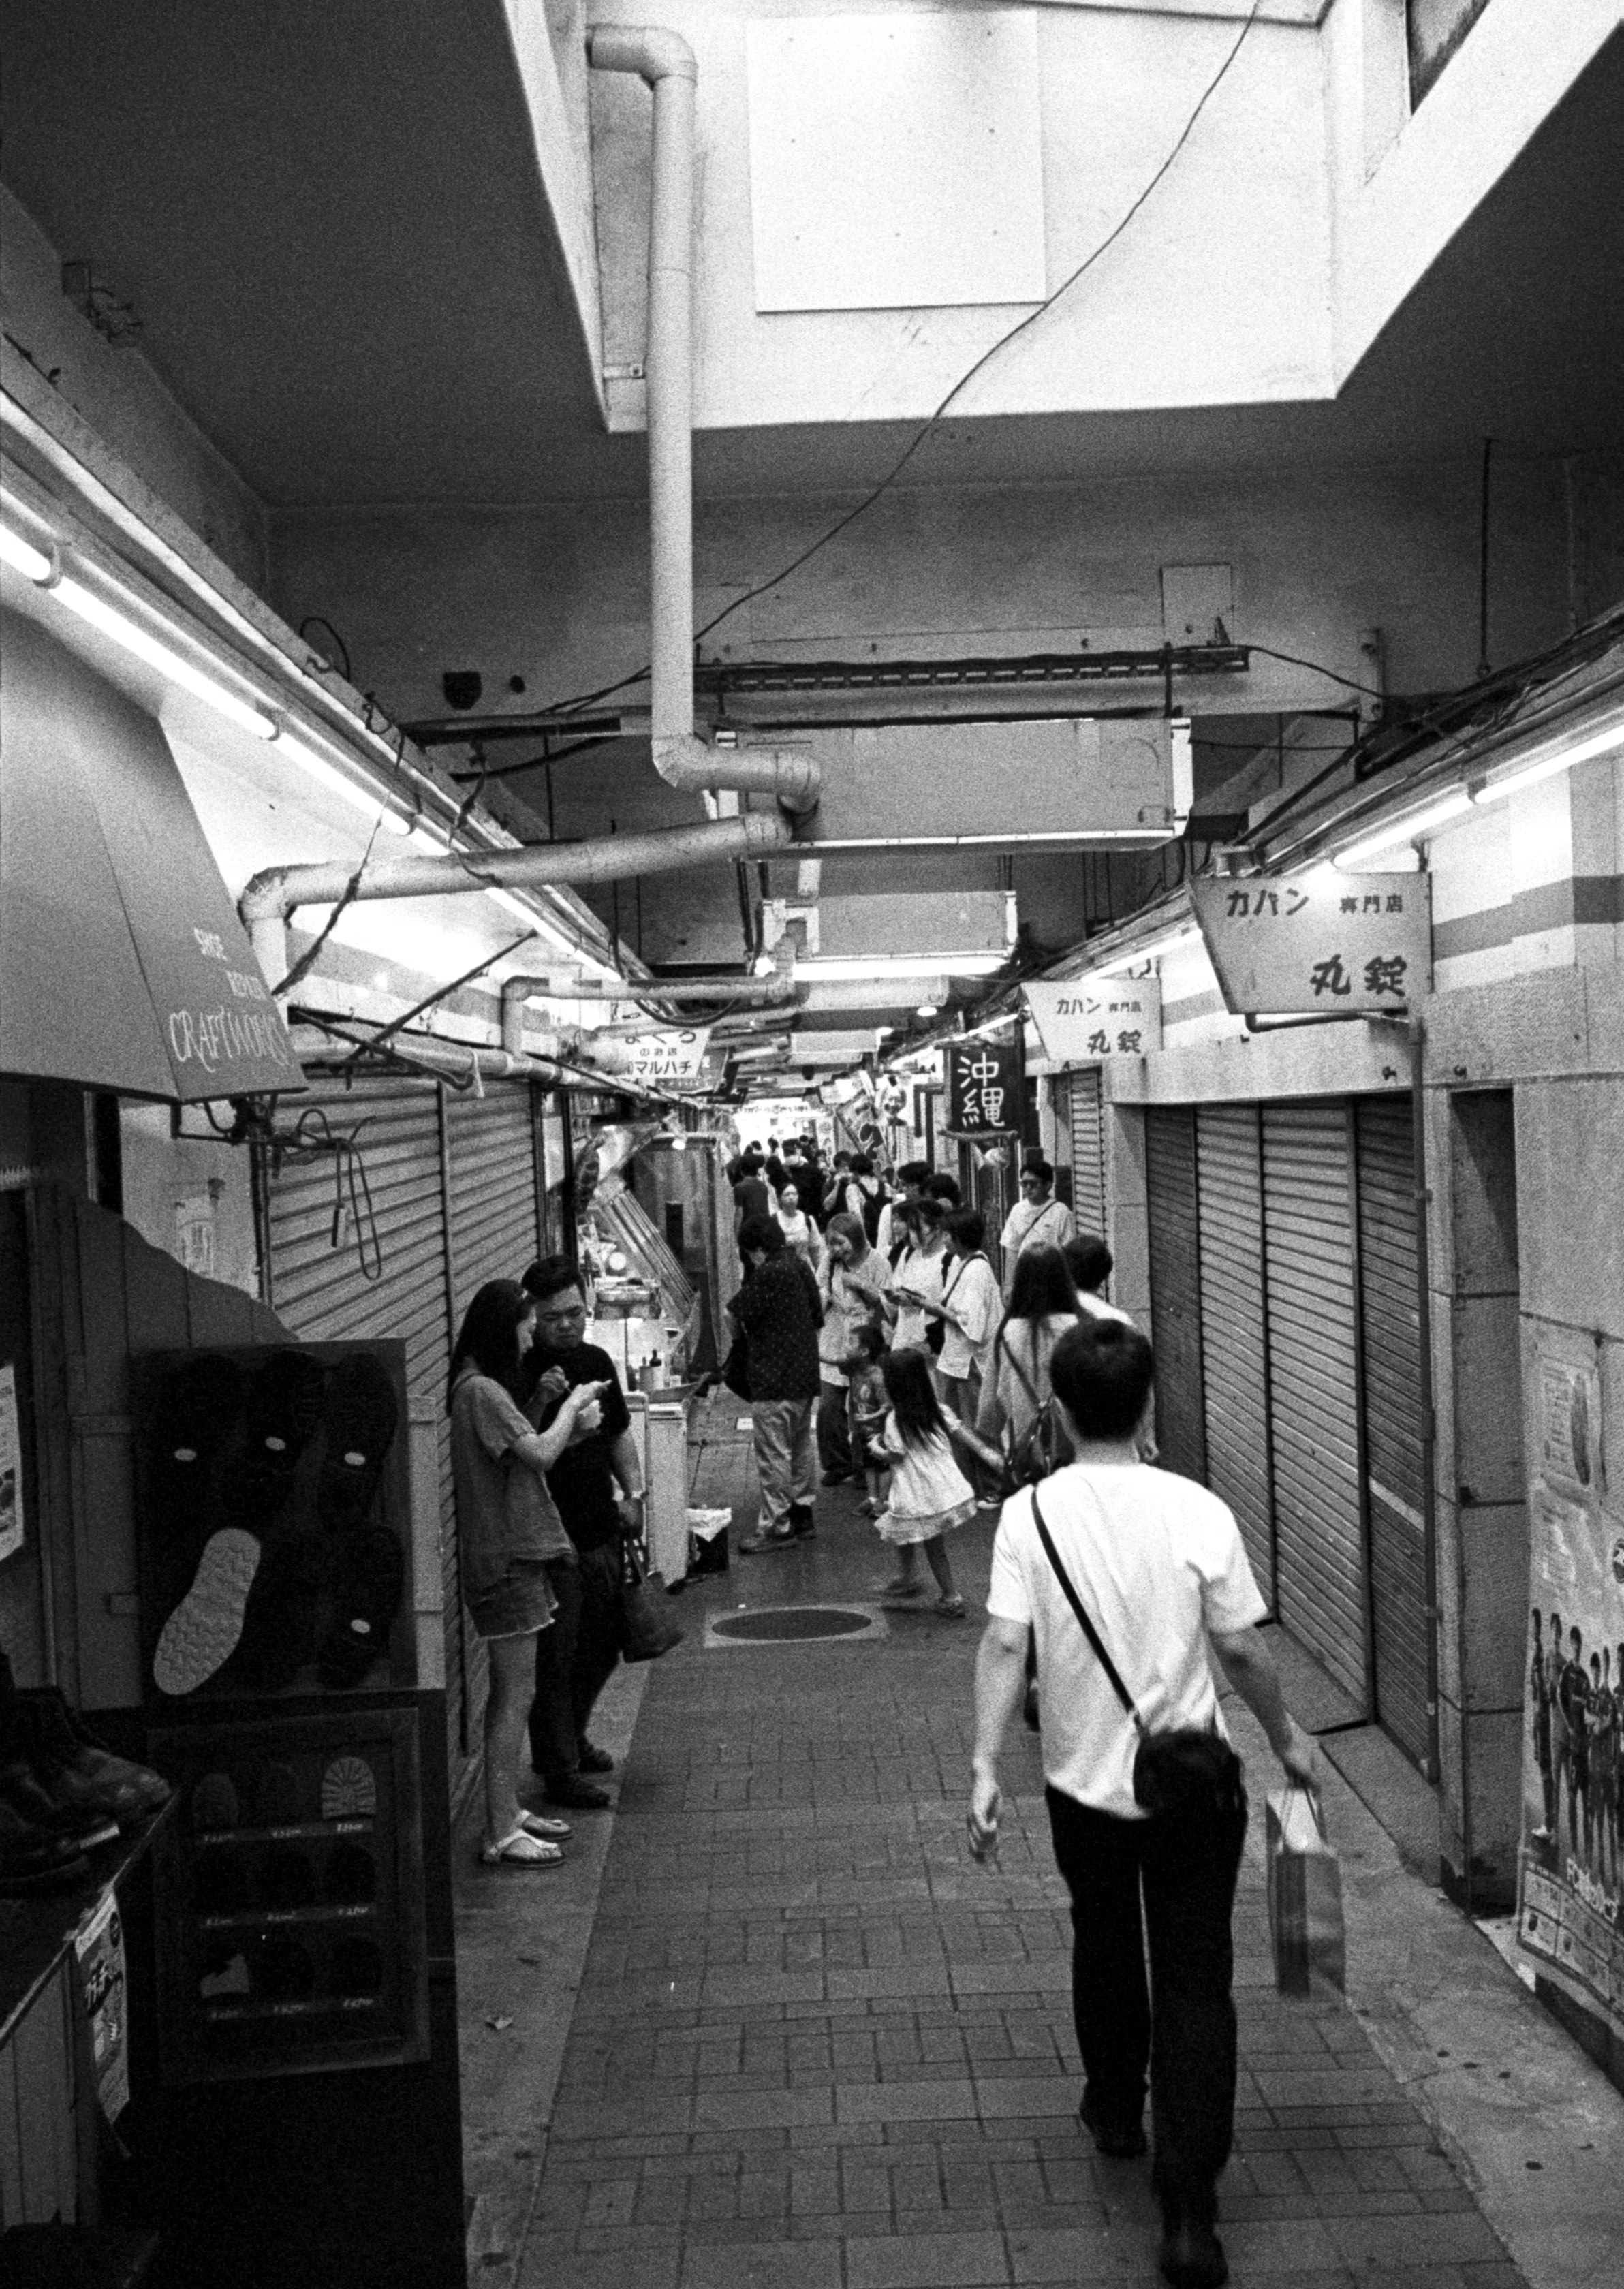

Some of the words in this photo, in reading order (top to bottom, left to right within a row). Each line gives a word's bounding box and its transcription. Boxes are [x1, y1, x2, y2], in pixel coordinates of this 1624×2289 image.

[1310, 953, 1407, 997] 丸錠
[1088, 1029, 1142, 1054] 丸錠
[957, 1053, 1005, 1128] 沖縄
